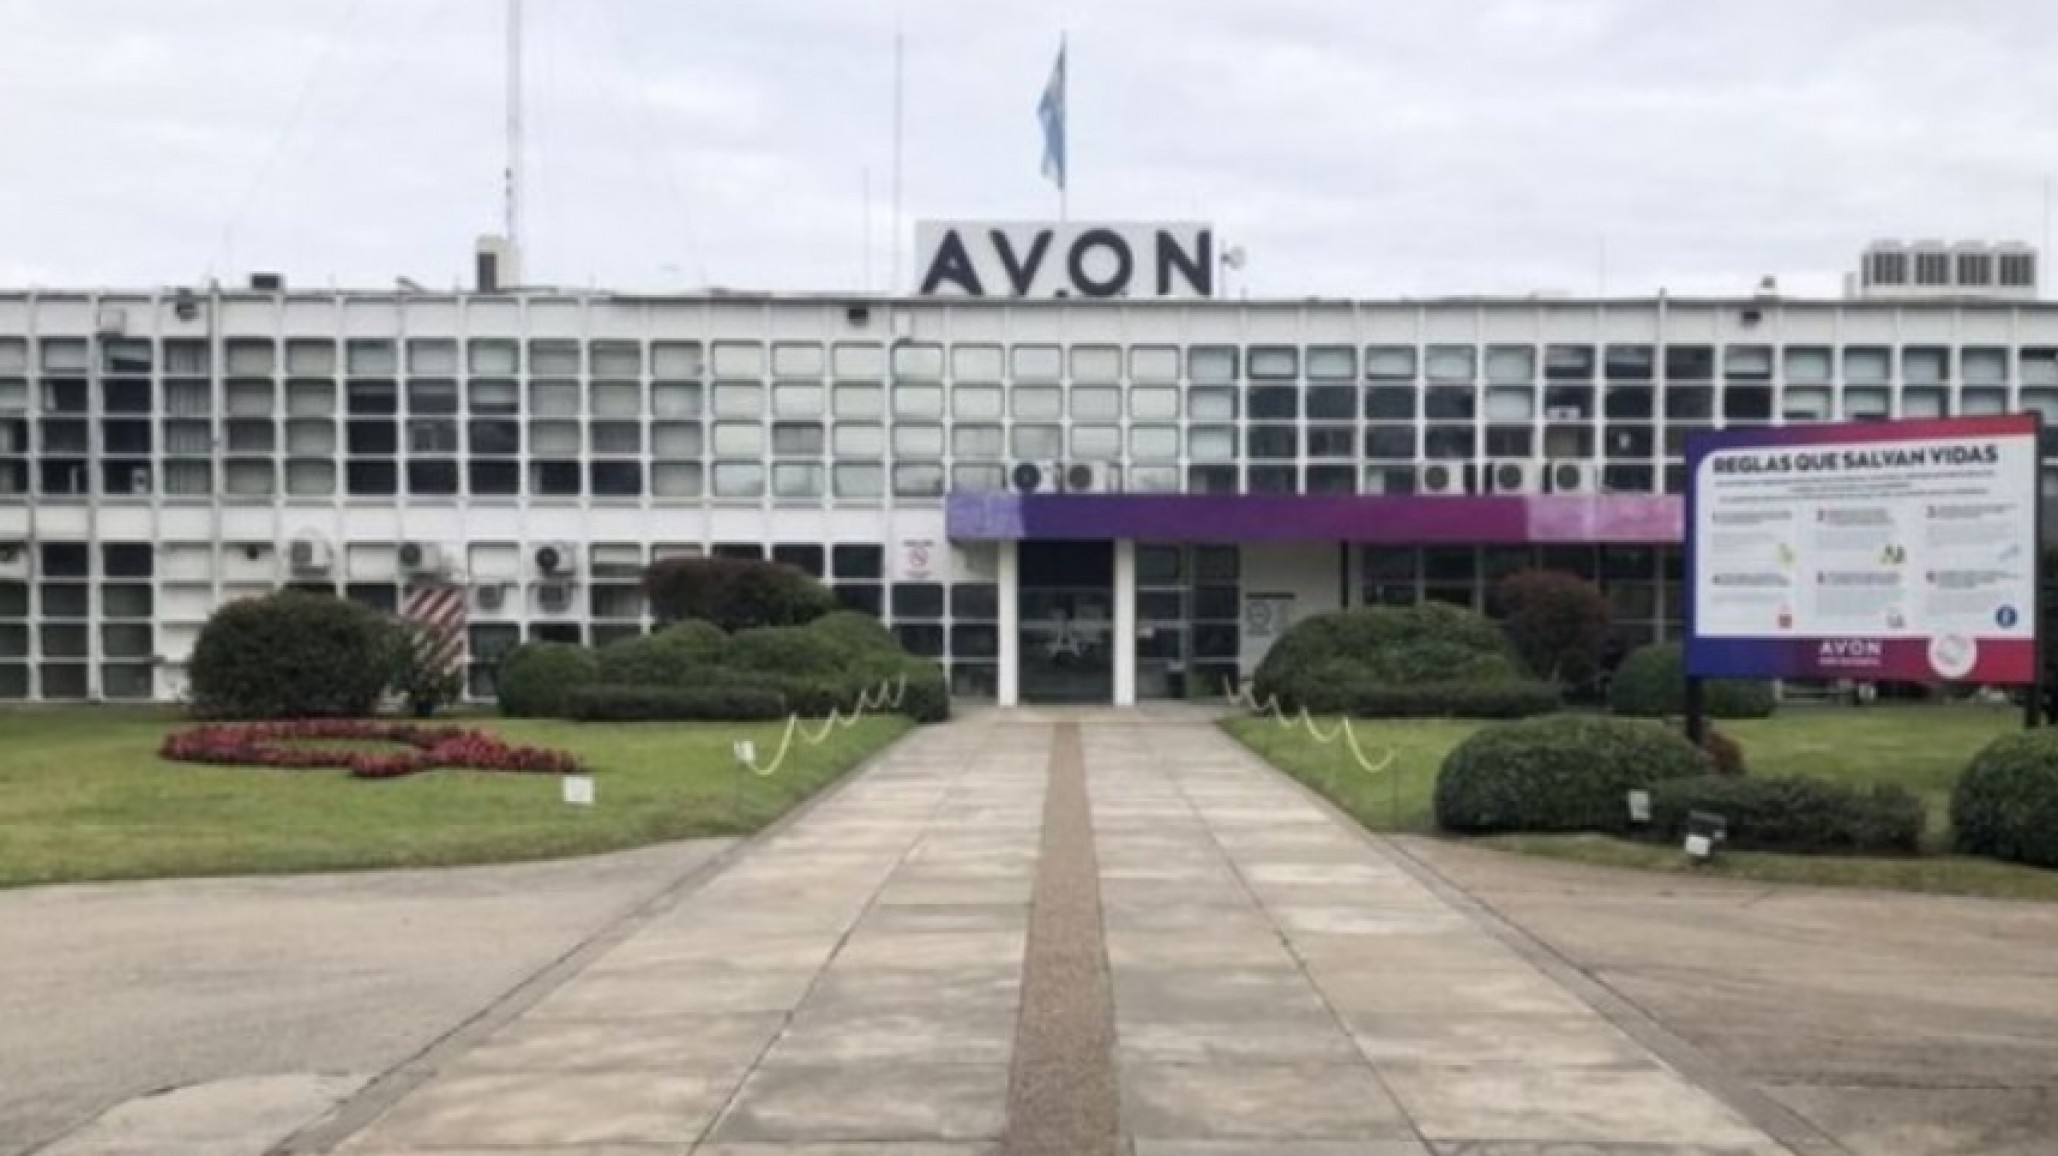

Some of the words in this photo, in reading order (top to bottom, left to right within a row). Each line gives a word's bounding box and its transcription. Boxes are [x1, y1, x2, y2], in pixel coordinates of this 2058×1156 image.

[919, 229, 1211, 297] AVON
[1713, 455, 1791, 474] REGLAS
[1795, 452, 1838, 471] QUE
[1843, 447, 1925, 468] SALVAN
[1930, 444, 1998, 464] VIDAS
[1820, 640, 1881, 655] AVON
